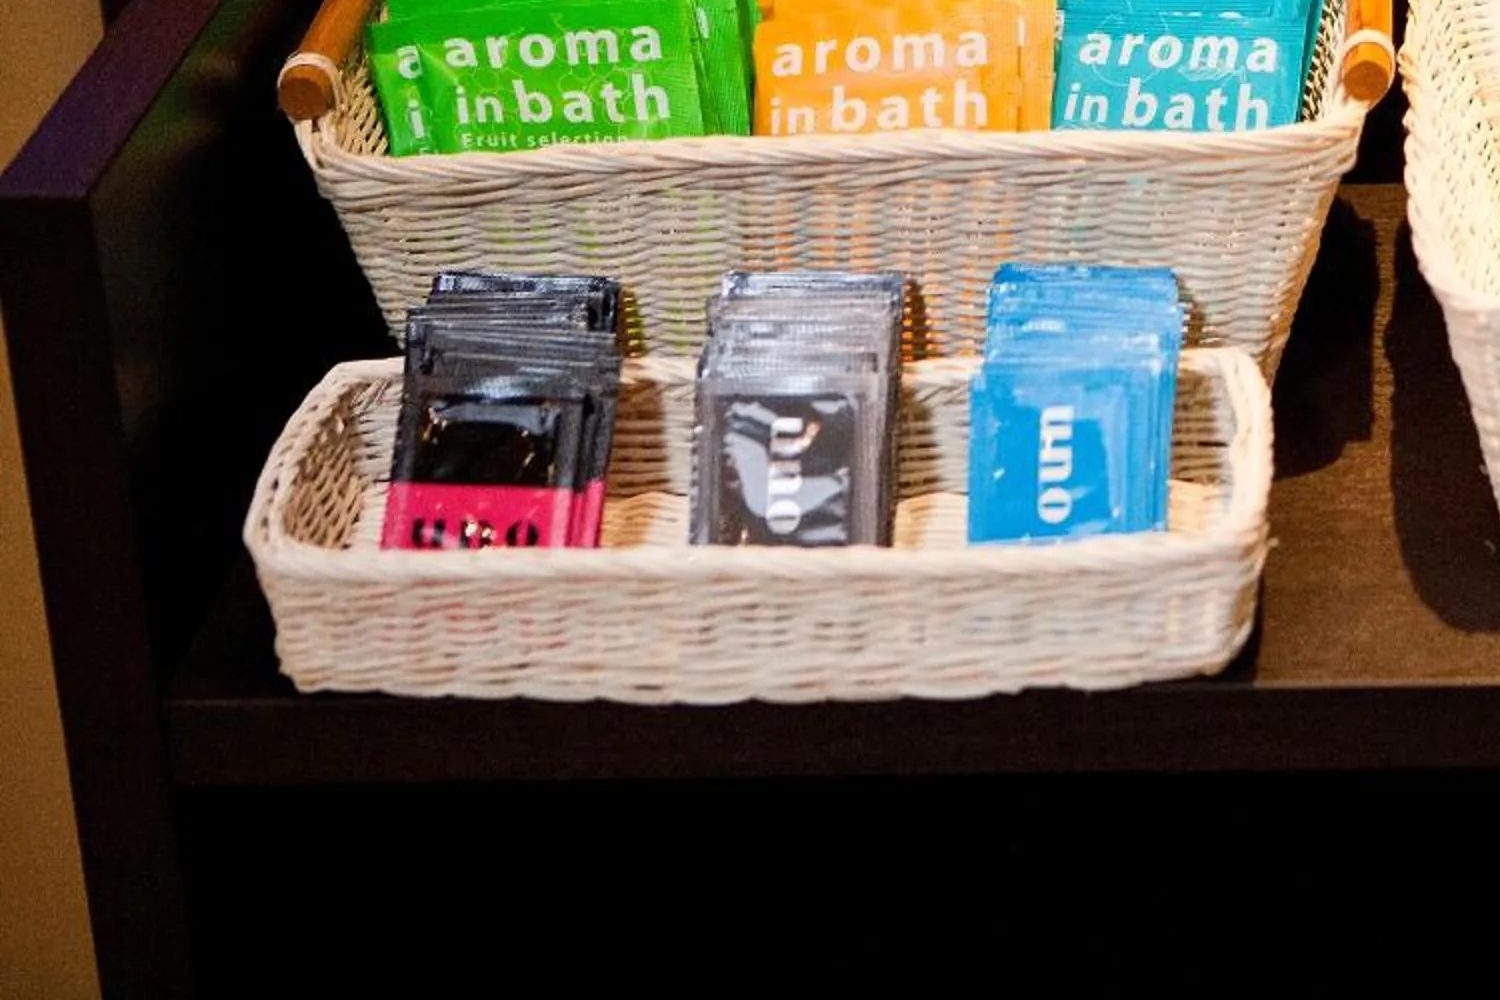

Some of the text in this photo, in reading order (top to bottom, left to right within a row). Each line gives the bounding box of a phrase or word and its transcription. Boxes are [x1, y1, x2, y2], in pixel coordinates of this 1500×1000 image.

[445, 25, 663, 69] aroma
[772, 30, 988, 77] aroma
[1079, 32, 1278, 74] aroma
[461, 131, 518, 149] Fruit
[767, 417, 803, 535] uno
[1037, 405, 1074, 525] uno
